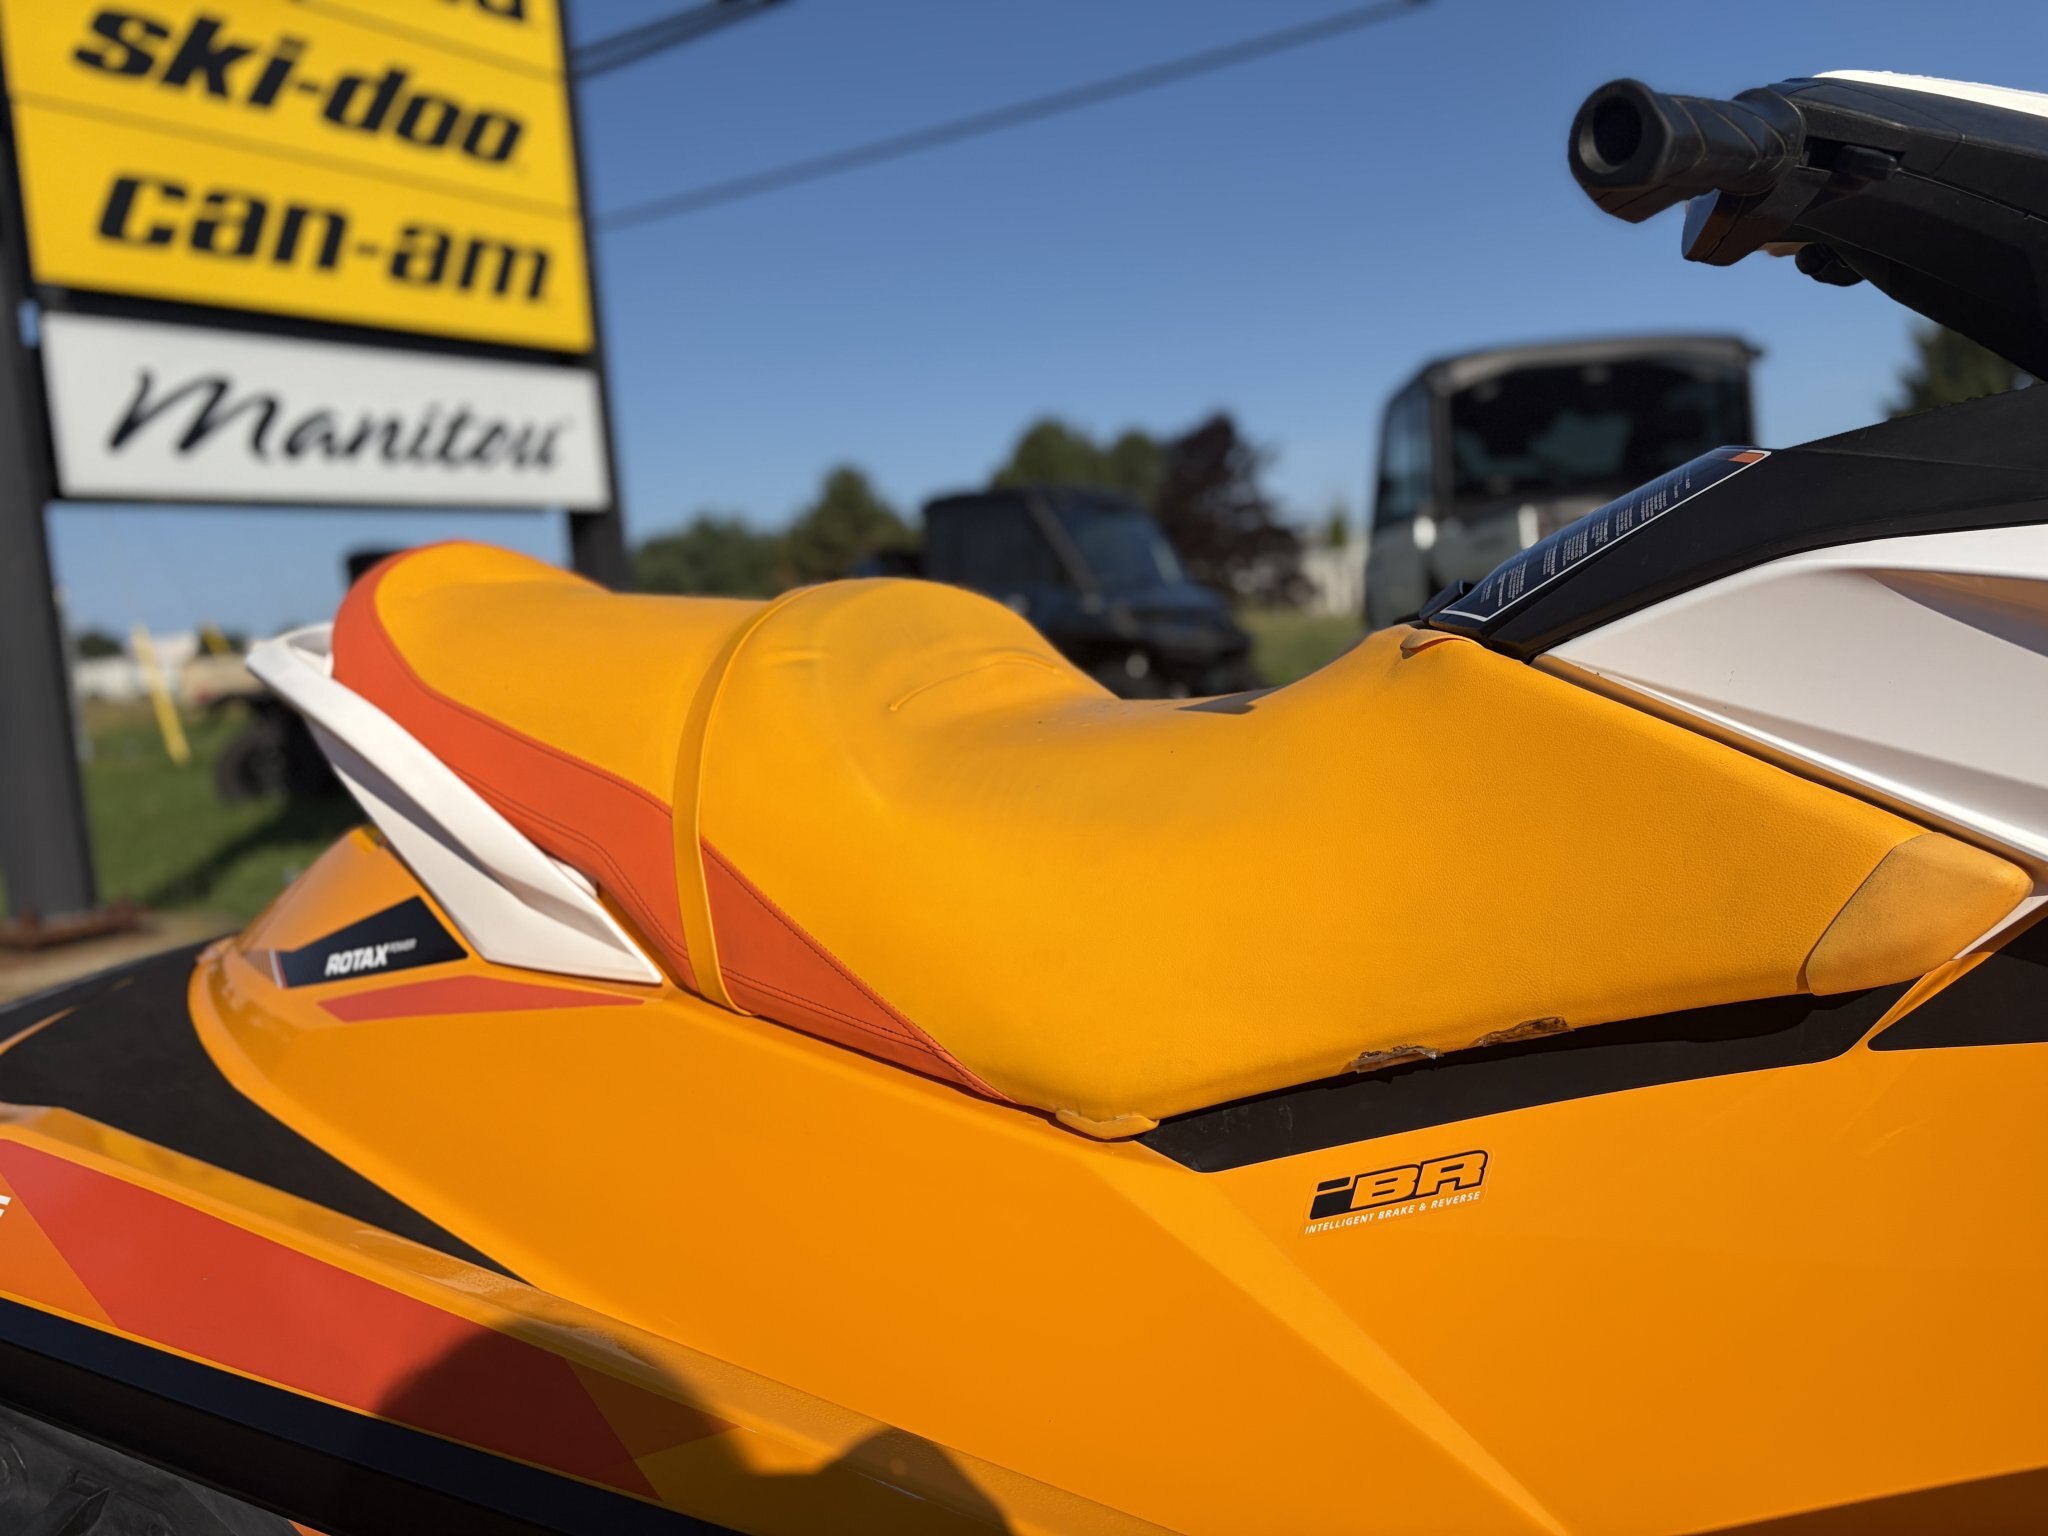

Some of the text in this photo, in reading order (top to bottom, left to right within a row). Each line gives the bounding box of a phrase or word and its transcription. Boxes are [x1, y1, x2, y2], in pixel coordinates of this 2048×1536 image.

[72, 6, 527, 166] ski-doo
[95, 172, 553, 302] can-am
[106, 368, 565, 472] Manitou
[324, 943, 389, 976] ROTAX
[1304, 1190, 1481, 1235] INTELLIGENT BRAKE & REVERSE
